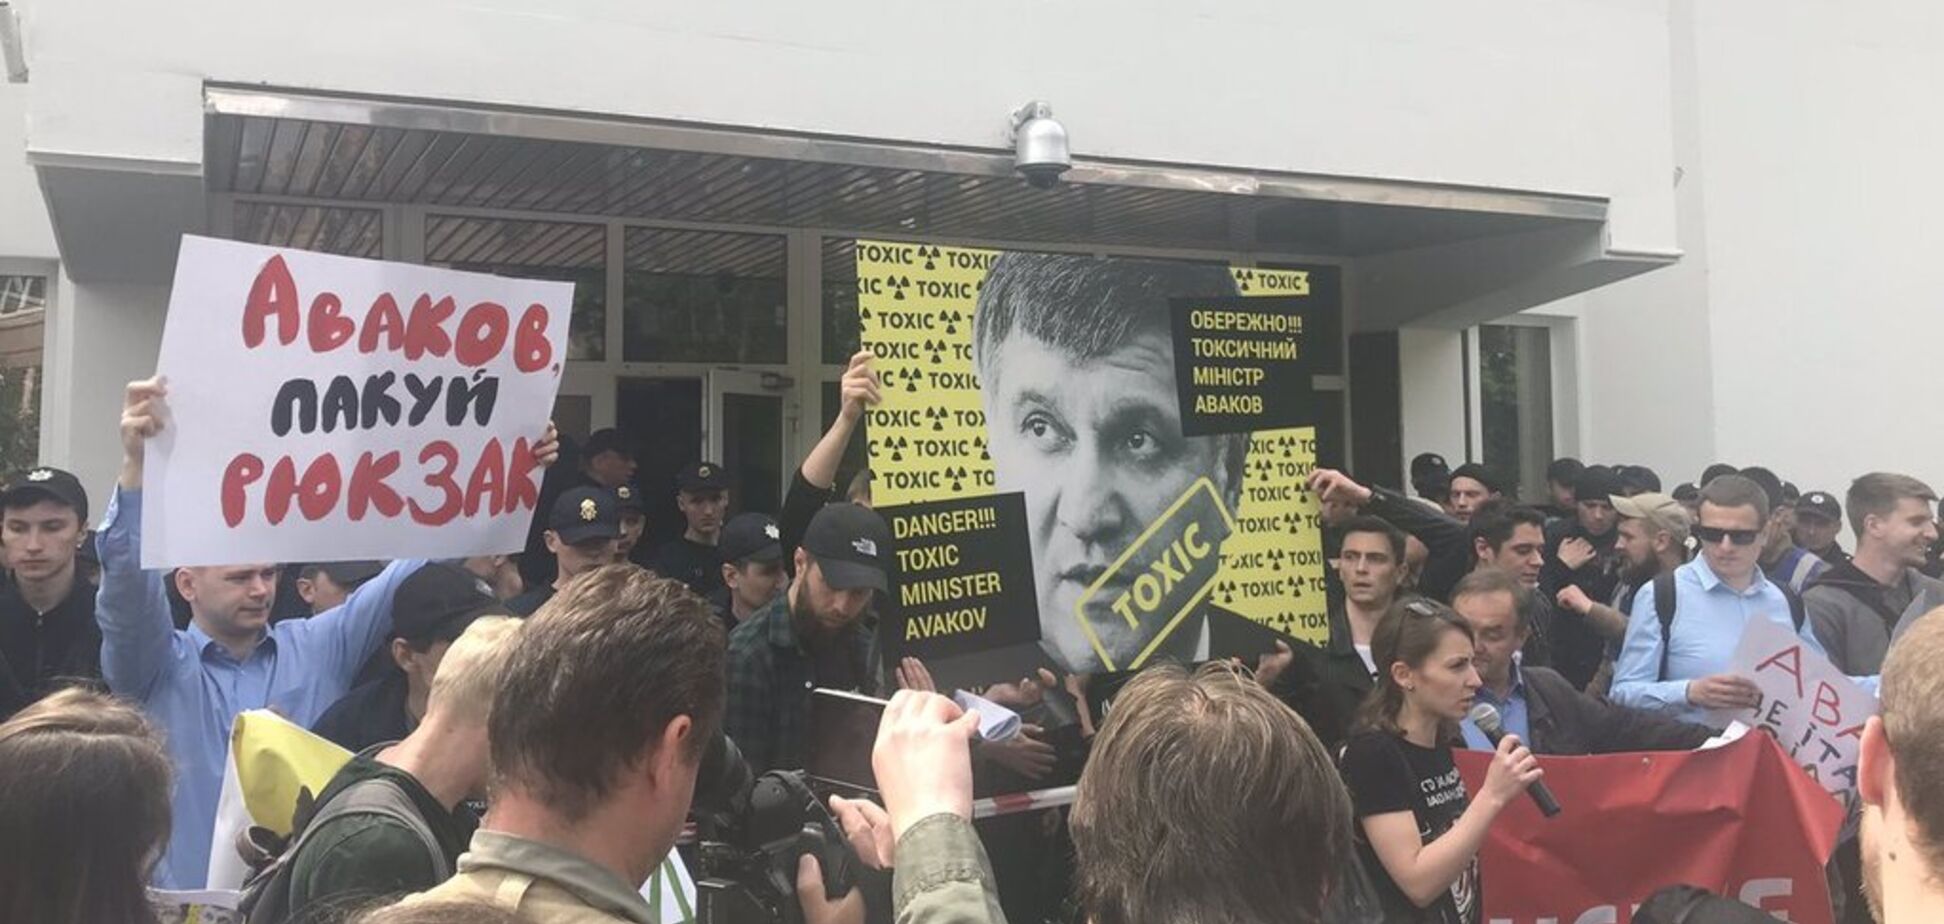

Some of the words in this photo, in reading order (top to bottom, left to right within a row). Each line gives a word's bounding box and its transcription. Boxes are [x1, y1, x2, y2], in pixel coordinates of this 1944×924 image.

[857, 245, 913, 264] TOXIC
[916, 281, 971, 299] TOXIC
[1258, 274, 1301, 290] TOXIC
[878, 312, 935, 329] TOXIC
[1190, 310, 1302, 333] ОБЕРЕЖНО!!!
[863, 342, 919, 359] TOXIC
[1191, 337, 1297, 360] ТОКСИЧНИЙ
[1193, 366, 1264, 386] МІНІСТР
[1195, 394, 1263, 414] АВАКОВ
[865, 410, 921, 427] TOXIC
[914, 440, 969, 457] TOXIC
[221, 436, 541, 528] РЮКЗАК
[883, 470, 940, 489] TOXIC
[1248, 486, 1291, 502] TOXIC
[893, 507, 996, 539] DANGER!!!
[1238, 517, 1281, 533] TOXIC
[896, 544, 960, 573] TOXIC
[1110, 522, 1212, 632] TOXIC
[901, 571, 1002, 607] MINISTER
[1241, 580, 1285, 598] TOXIC
[905, 606, 987, 641] AVAKOV
